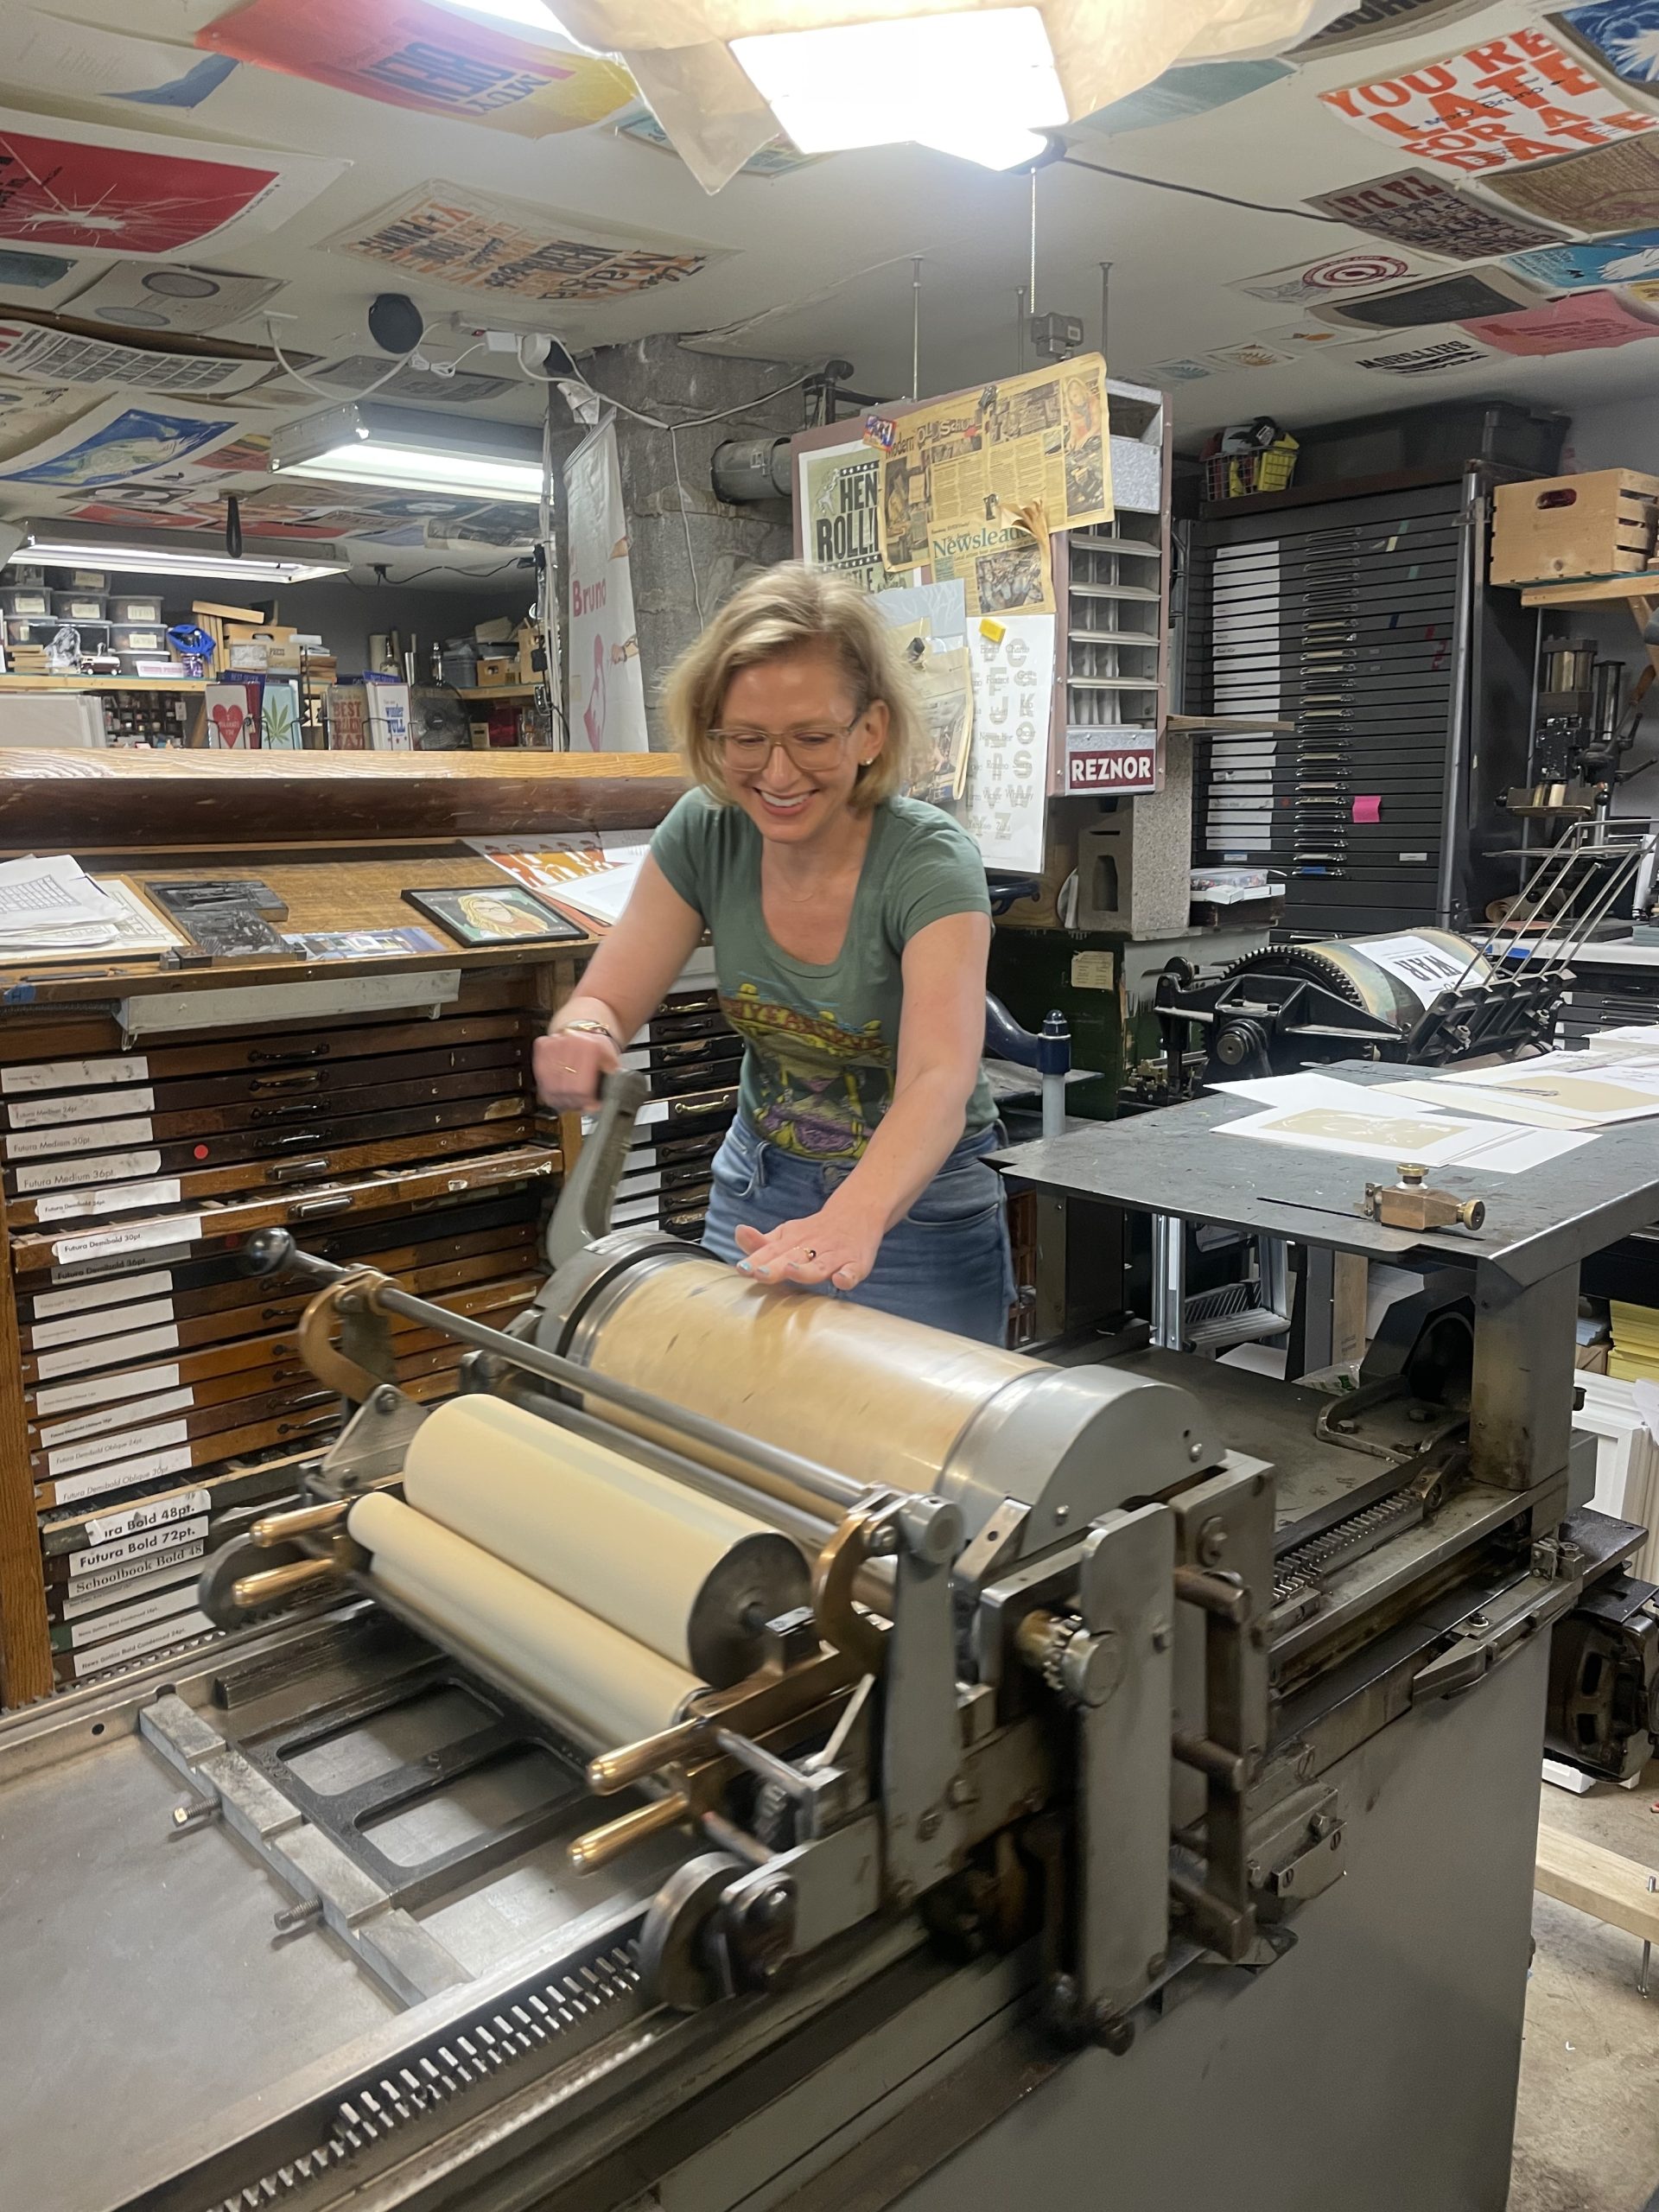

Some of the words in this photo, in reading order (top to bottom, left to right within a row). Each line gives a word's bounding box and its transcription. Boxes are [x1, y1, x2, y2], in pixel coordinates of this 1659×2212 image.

[1318, 27, 1554, 118] YOU'RE
[464, 73, 553, 111] MUY
[1369, 49, 1603, 143] LATE
[1482, 86, 1543, 108] Bruno
[1400, 123, 1524, 157] FOR
[1537, 106, 1591, 129] A
[1431, 109, 1657, 172] DATE
[1071, 756, 1151, 782] REZNOR
[1392, 955, 1461, 980] WAR
[14, 1141, 37, 1153] Futura
[40, 1138, 70, 1149] Medium
[23, 1176, 52, 1188] Futura
[54, 1172, 90, 1185] Medium
[65, 1243, 87, 1252] Futura
[90, 1236, 123, 1249] Demibold
[57, 1269, 85, 1280] Futura
[86, 1260, 124, 1276] Demibold
[63, 1488, 86, 1501] Futura
[87, 1478, 121, 1496] Demibold
[123, 1470, 151, 1486] Oblique
[128, 1512, 157, 1532] Bold
[161, 1504, 195, 1522] 48pt.
[79, 1546, 124, 1568] Futura
[128, 1535, 158, 1553] Bold
[162, 1528, 196, 1546] 72pt.
[76, 1561, 153, 1593] Schoolbook
[156, 1549, 185, 1567] Bold
